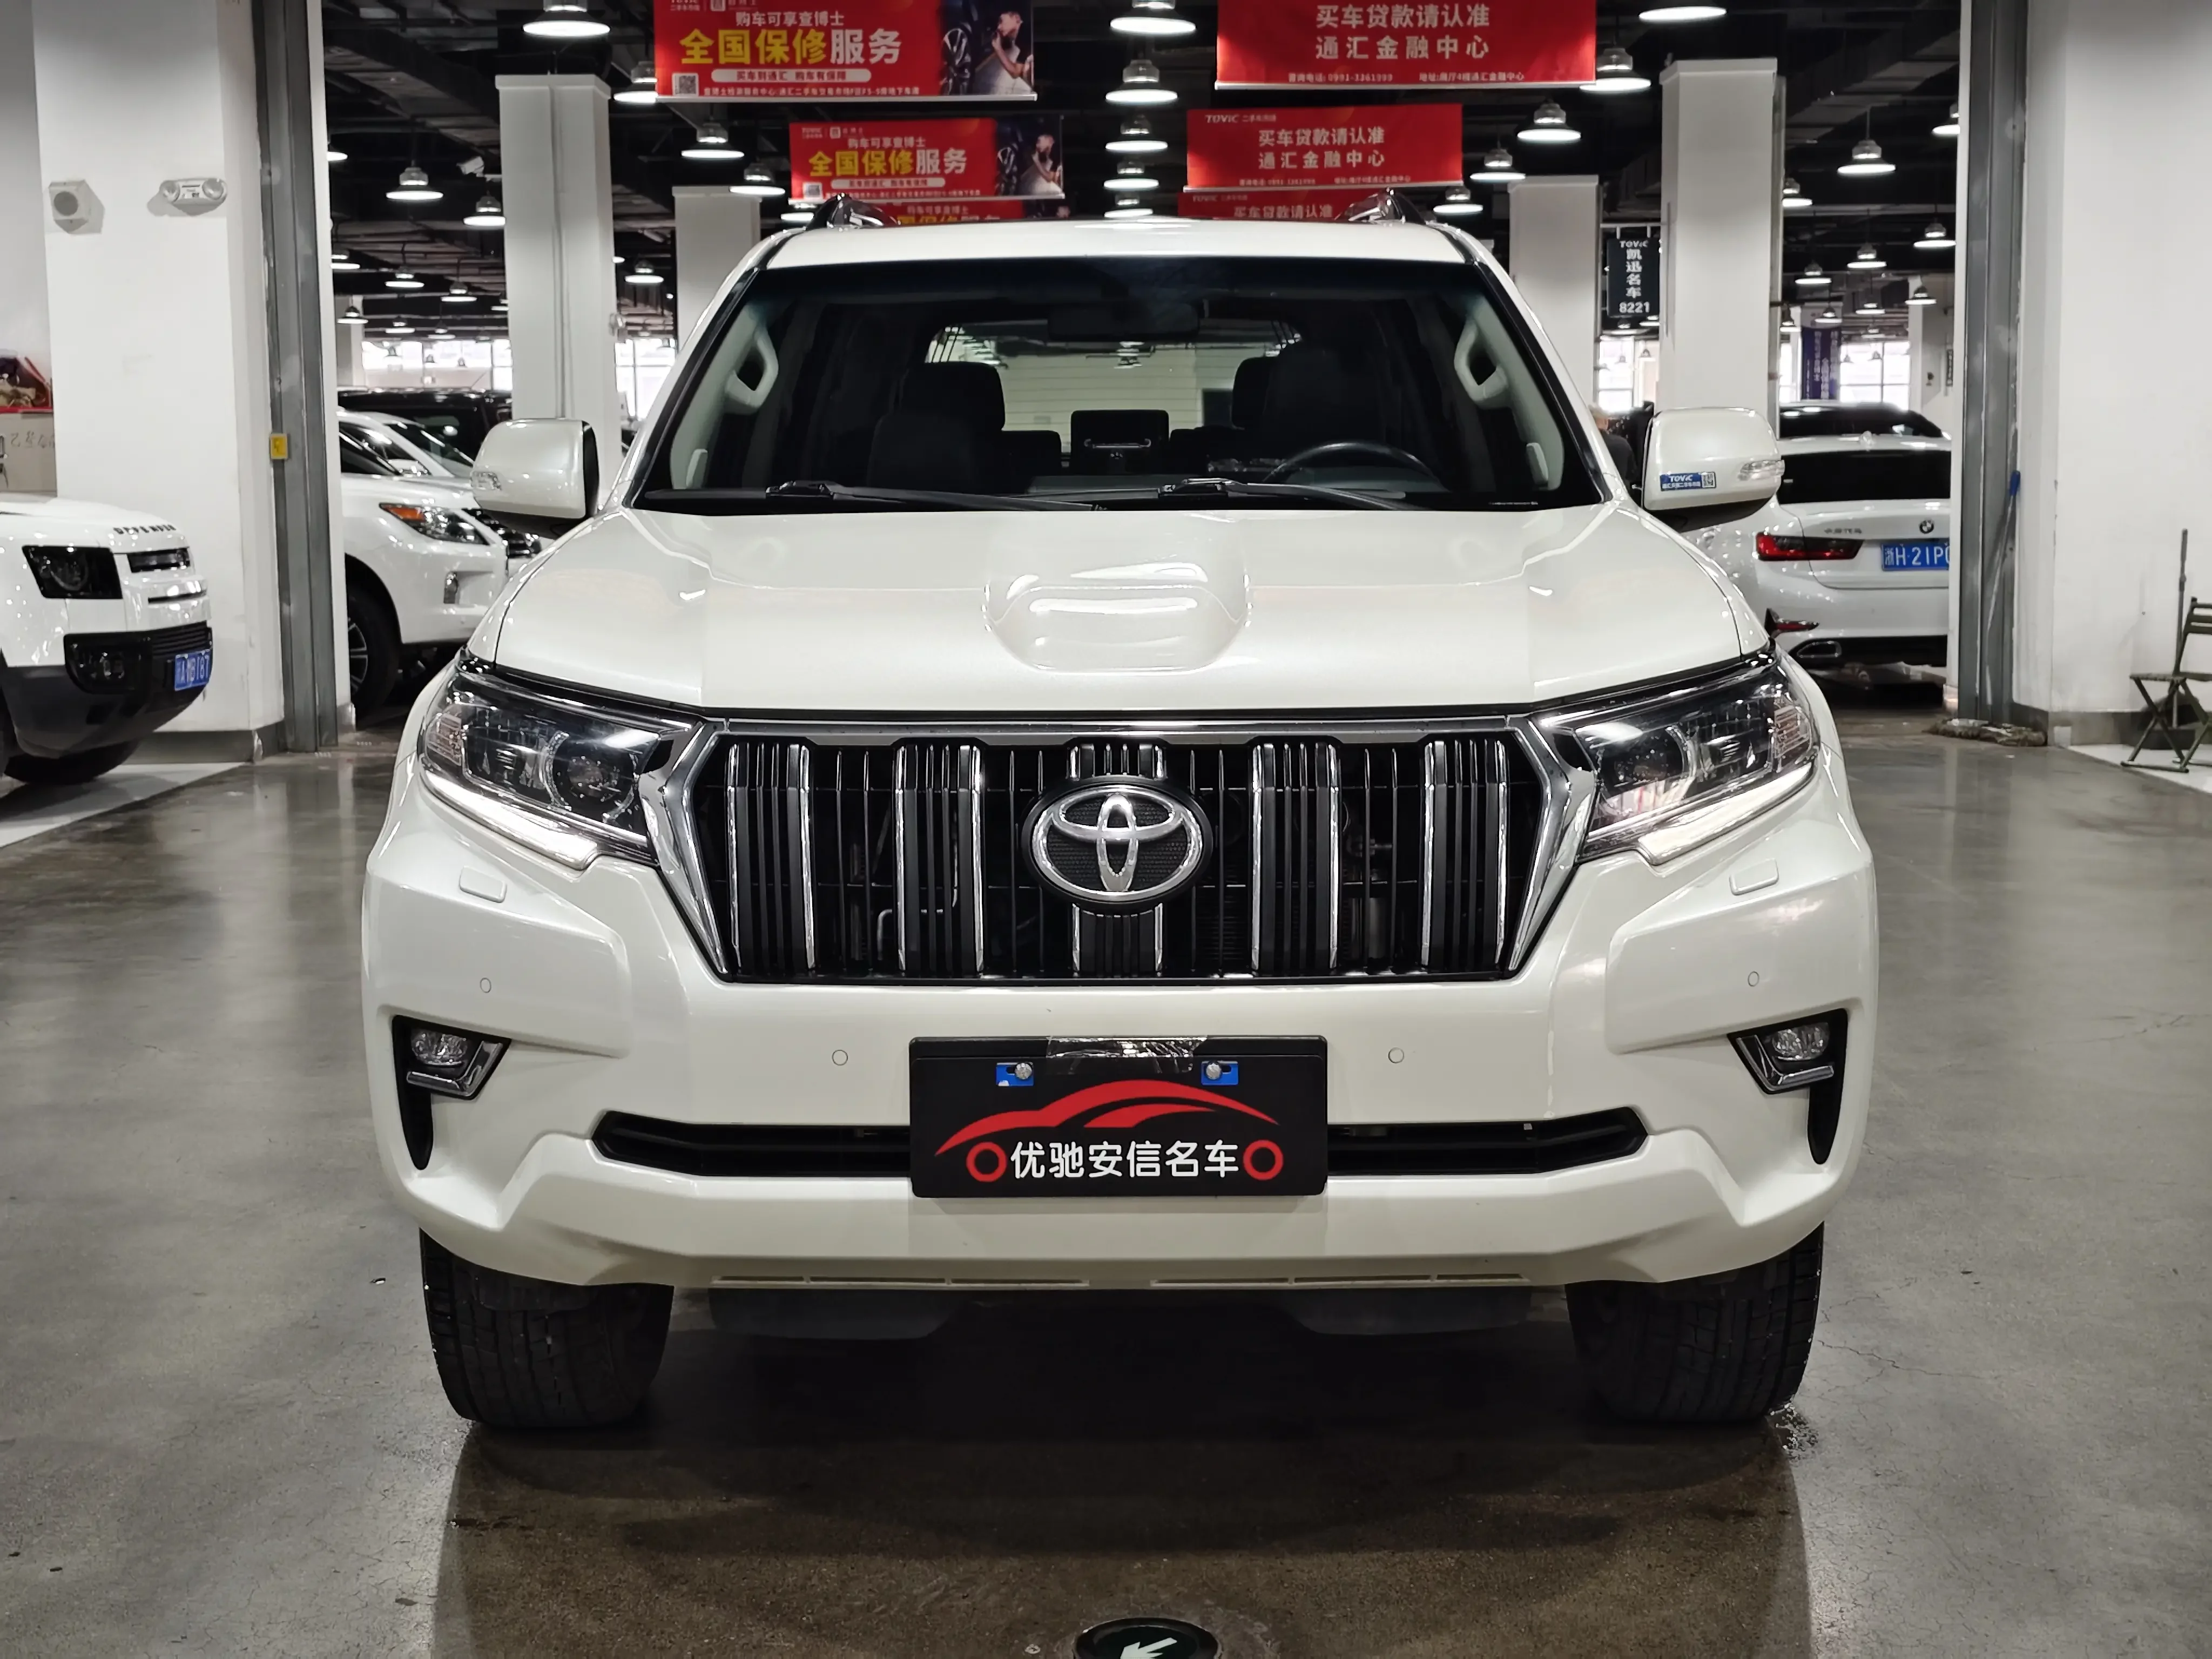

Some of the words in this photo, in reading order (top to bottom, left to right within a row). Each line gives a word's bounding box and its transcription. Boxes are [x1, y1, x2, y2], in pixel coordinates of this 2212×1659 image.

[736, 11, 845, 26] 购车可享查博士
[1316, 4, 1490, 28] 买车贷款请认准
[679, 28, 902, 65] 全国保修服务
[1315, 35, 1489, 59] 通汇金融中心
[1259, 126, 1386, 147] 买车贷款请认准
[809, 147, 967, 177] 全国保修服务
[1258, 150, 1385, 169] 通汇金融中心
[1619, 301, 1650, 314] 8221
[1010, 1140, 1239, 1178] 优驰安信名车
